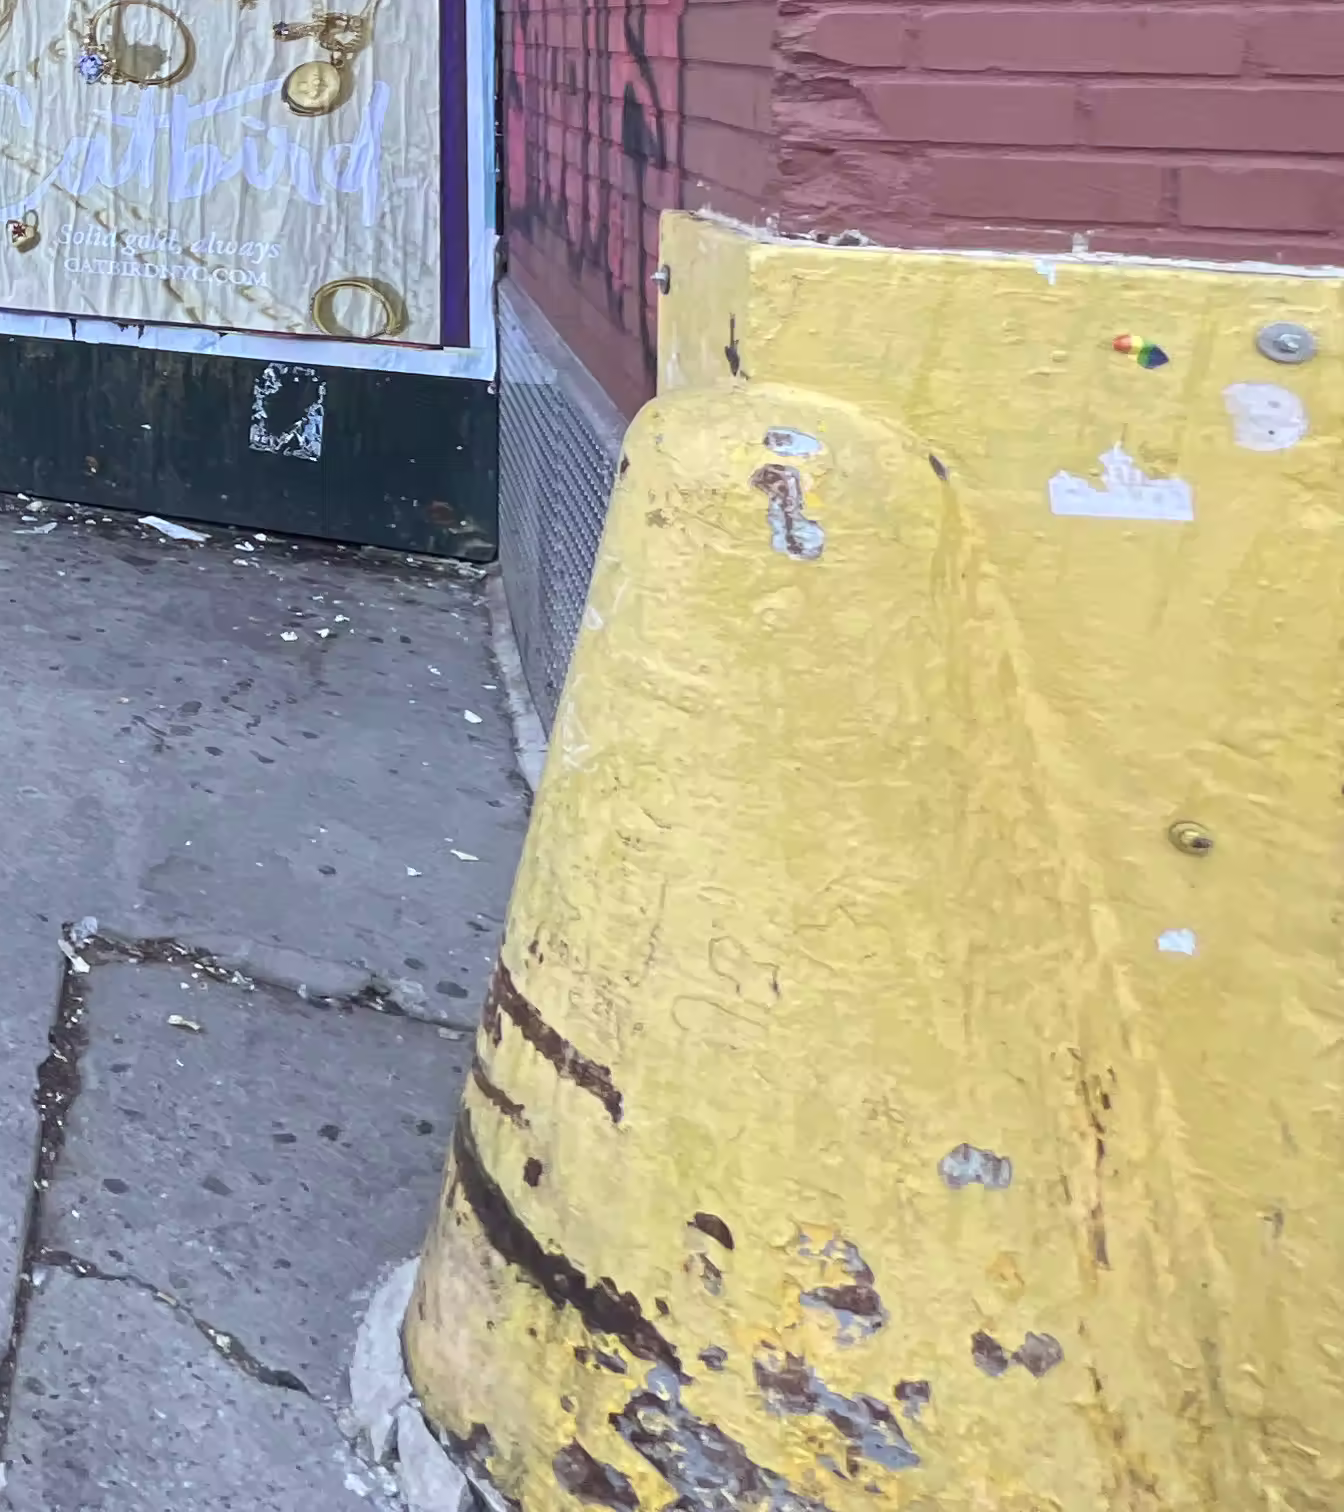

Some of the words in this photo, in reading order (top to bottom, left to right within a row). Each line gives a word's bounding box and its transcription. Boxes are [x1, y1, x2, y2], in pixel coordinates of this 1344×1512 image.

[57, 223, 119, 247] Solid
[121, 227, 183, 256] gold,
[191, 233, 281, 265] always
[63, 257, 268, 287] CATBIRDNYC.COM
